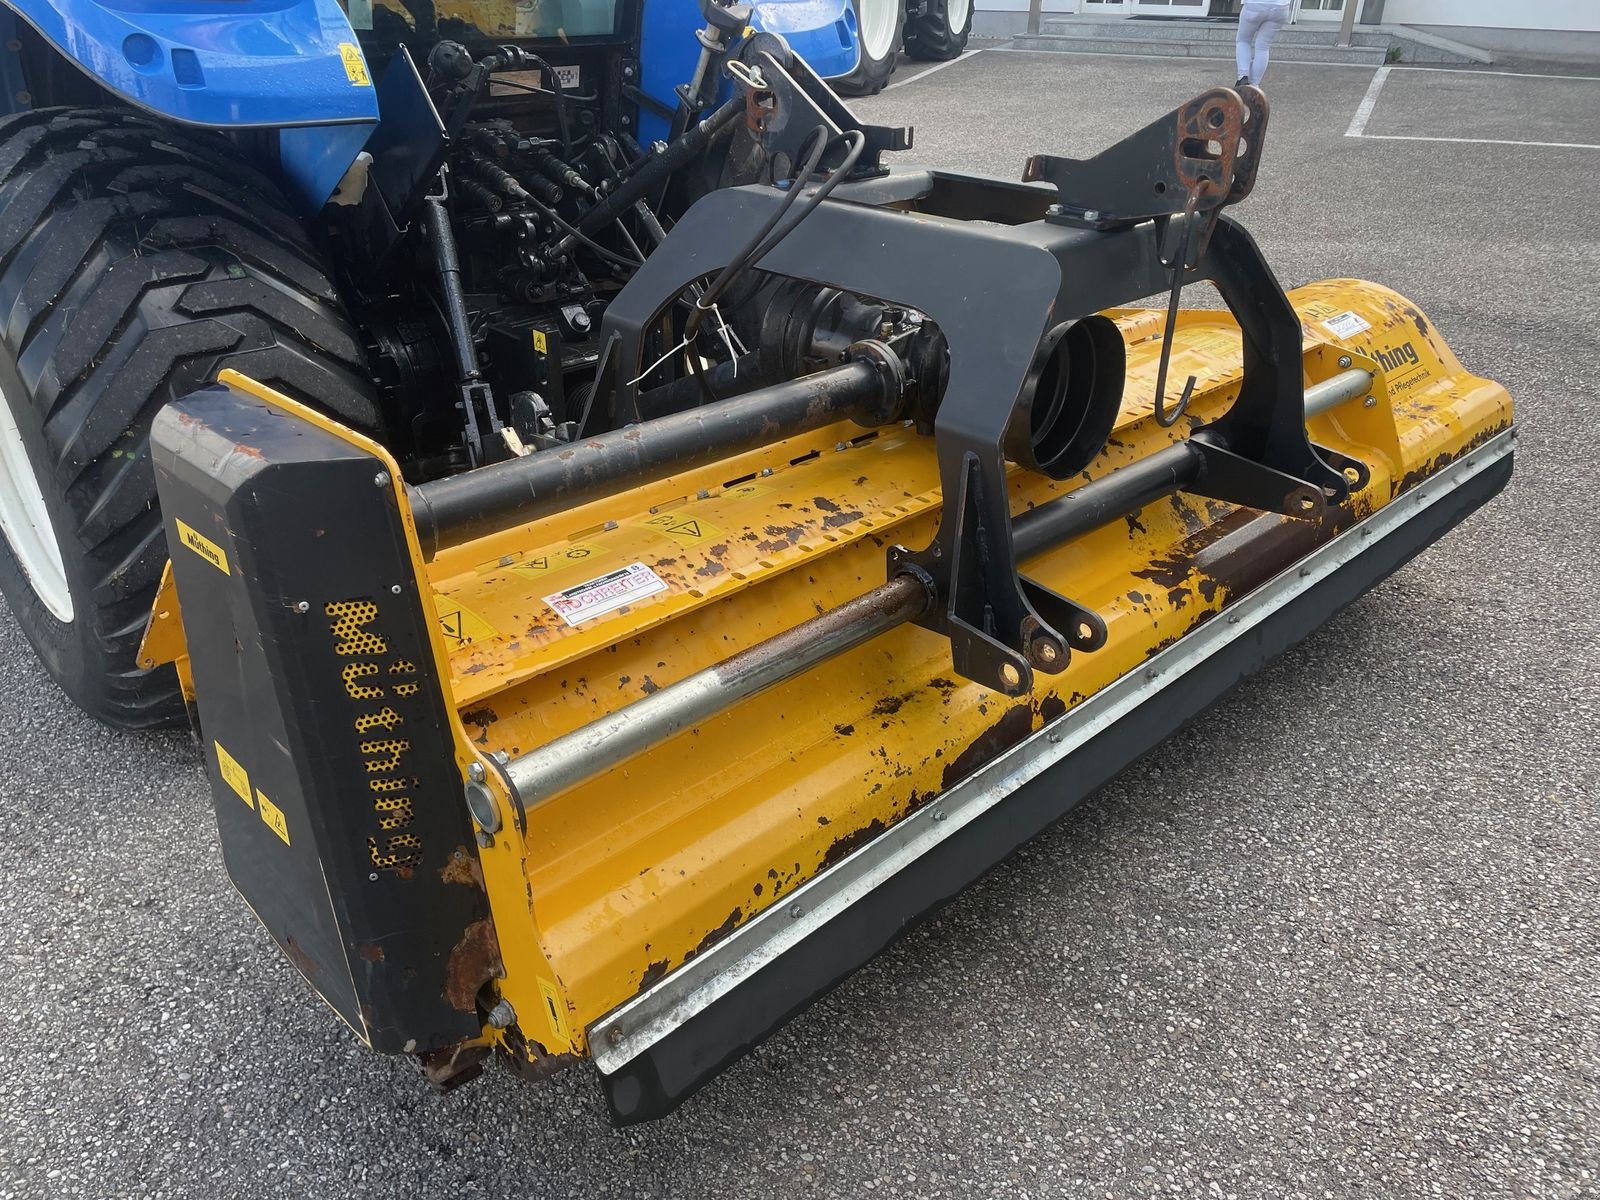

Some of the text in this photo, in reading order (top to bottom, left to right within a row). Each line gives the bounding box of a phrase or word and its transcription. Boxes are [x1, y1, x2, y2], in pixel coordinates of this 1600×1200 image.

[1355, 341, 1419, 373] hing
[1395, 369, 1431, 392] Pflegetechnik
[187, 532, 220, 566] Müthing
[324, 599, 424, 870] Müthing
